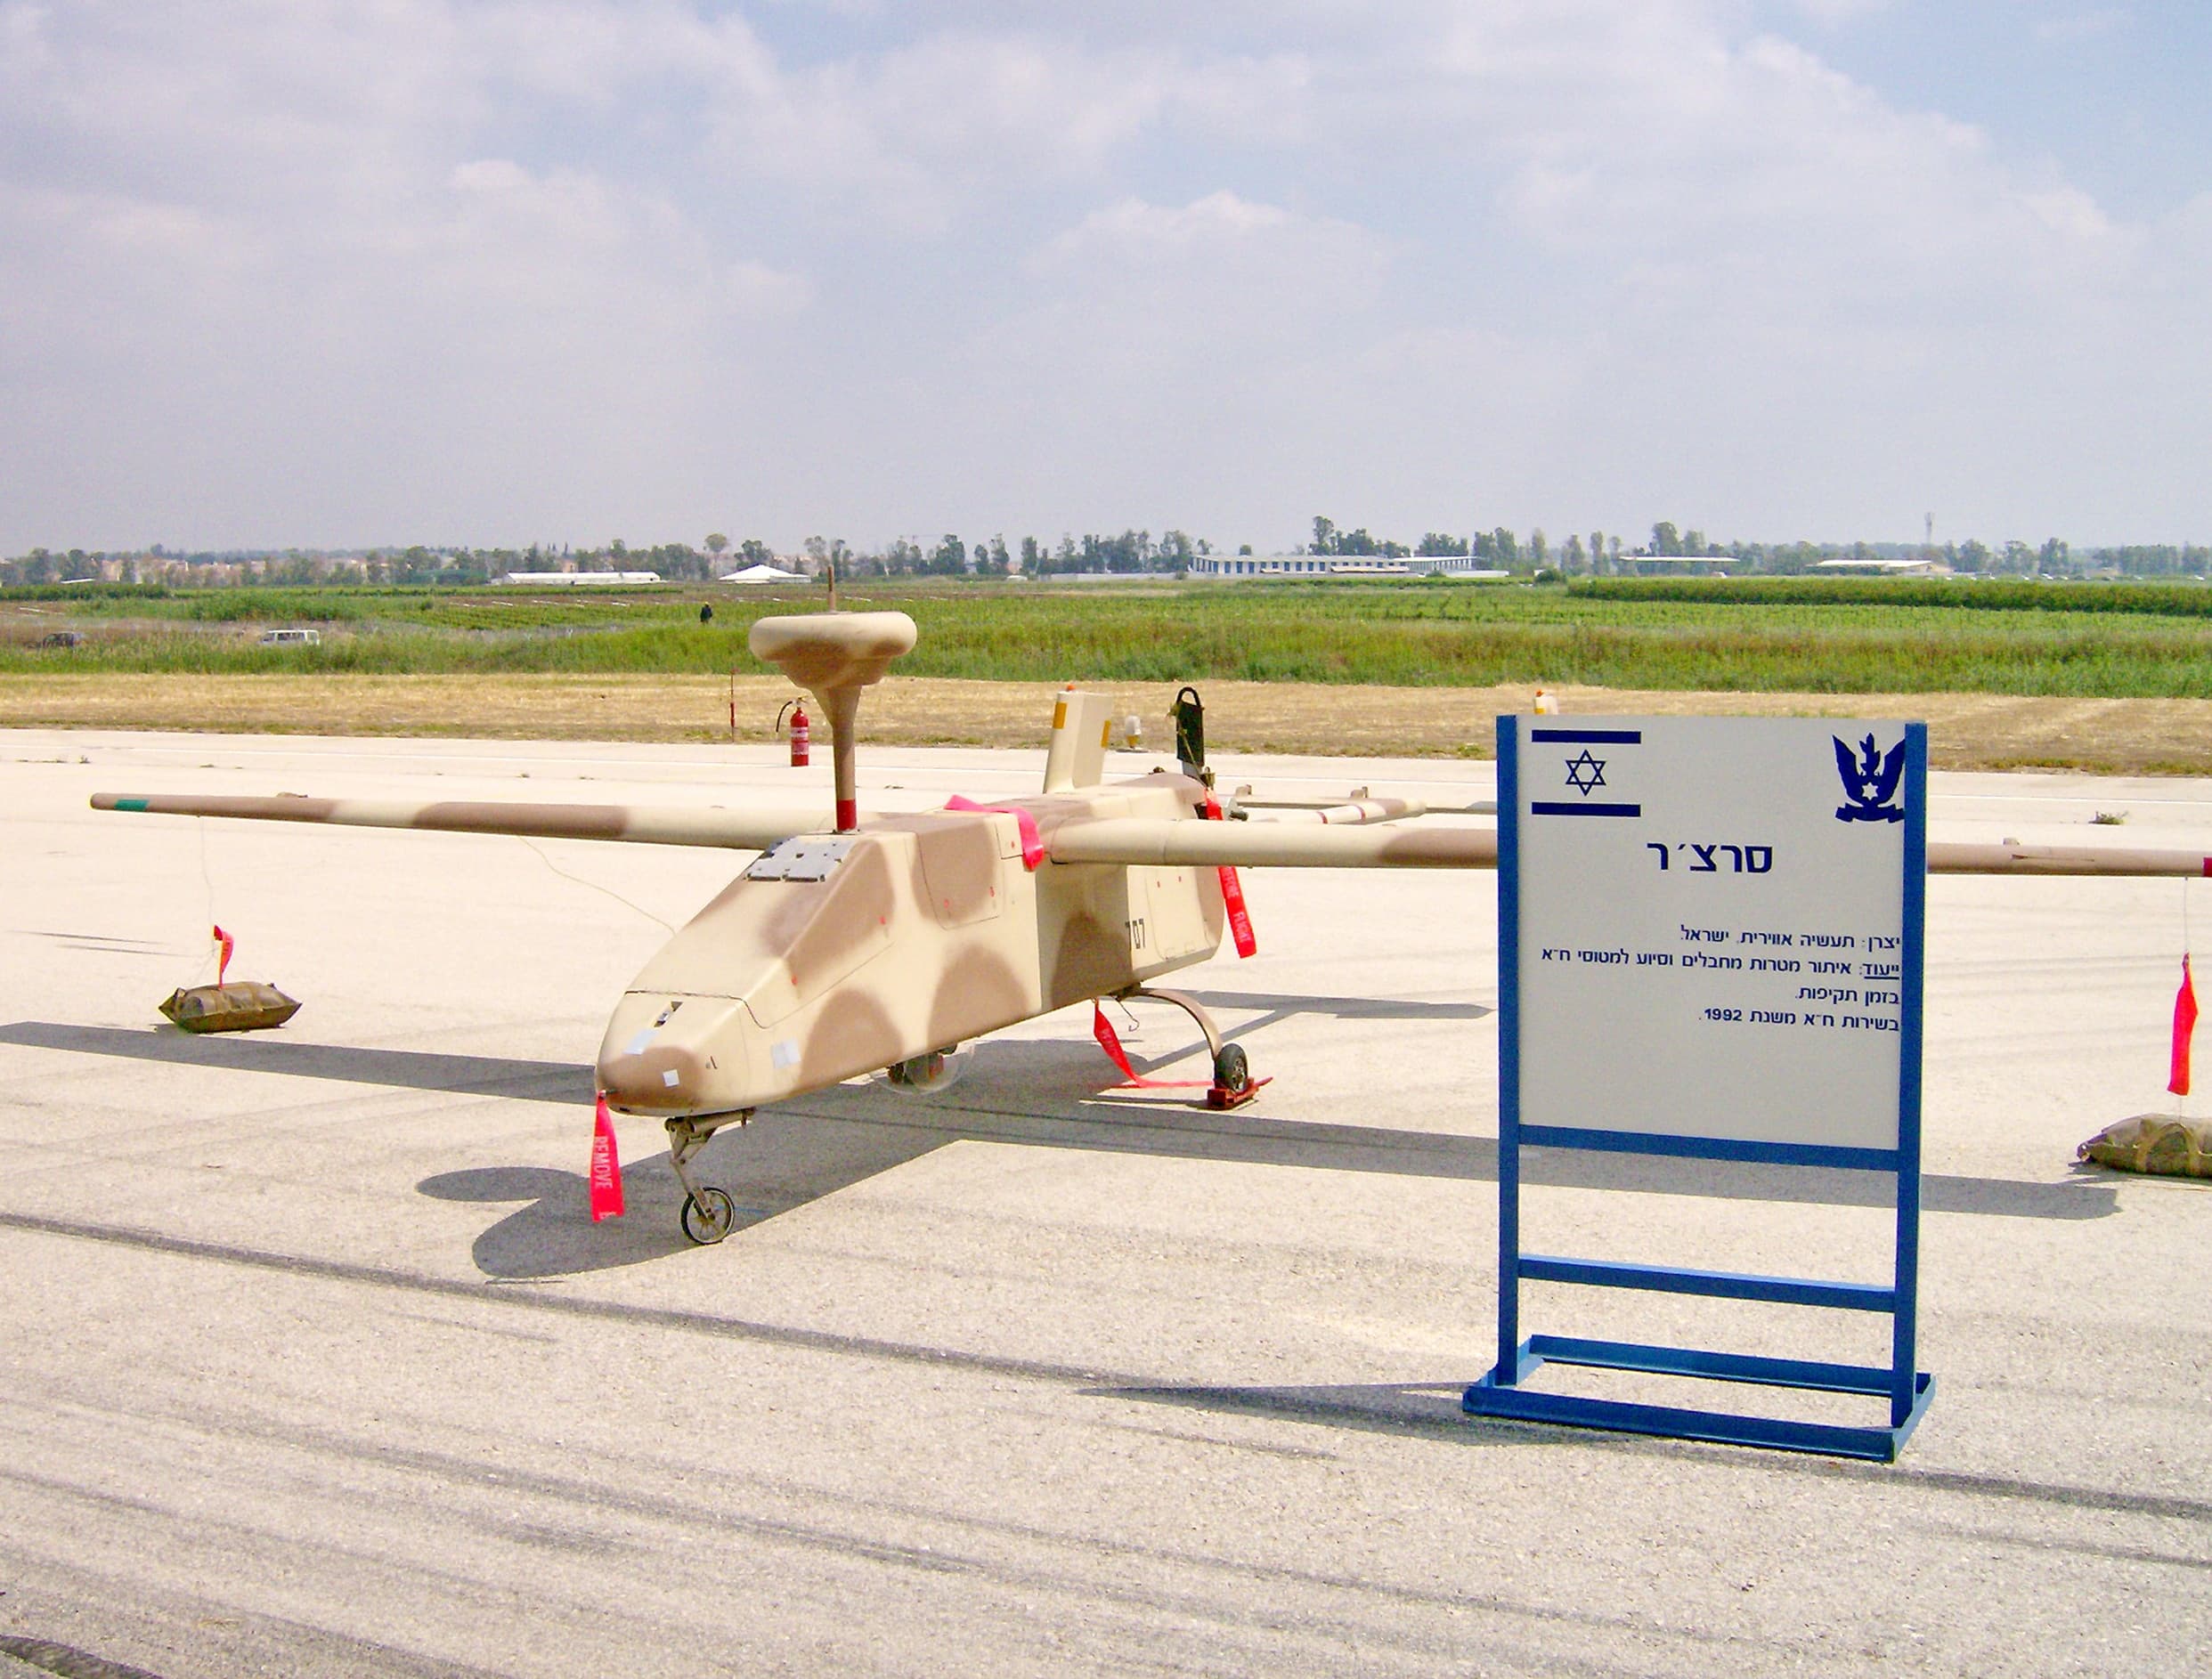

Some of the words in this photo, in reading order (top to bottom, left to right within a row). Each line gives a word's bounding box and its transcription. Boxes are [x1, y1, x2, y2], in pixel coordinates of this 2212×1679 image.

[1800, 934, 1855, 948] תעשיה
[1577, 947, 1630, 964] למטוסי
[1636, 953, 1673, 966] וסיוע
[1681, 951, 1743, 970] מחבלים
[1749, 958, 1801, 973] מטרות
[1808, 961, 1852, 975] איתור
[1794, 987, 1858, 1005] תקיפות.
[1865, 991, 1900, 1007] בזמן
[1749, 1010, 1796, 1026] משנת
[1841, 1016, 1900, 1032] בשירות
[593, 1135, 614, 1189] REMOVE
